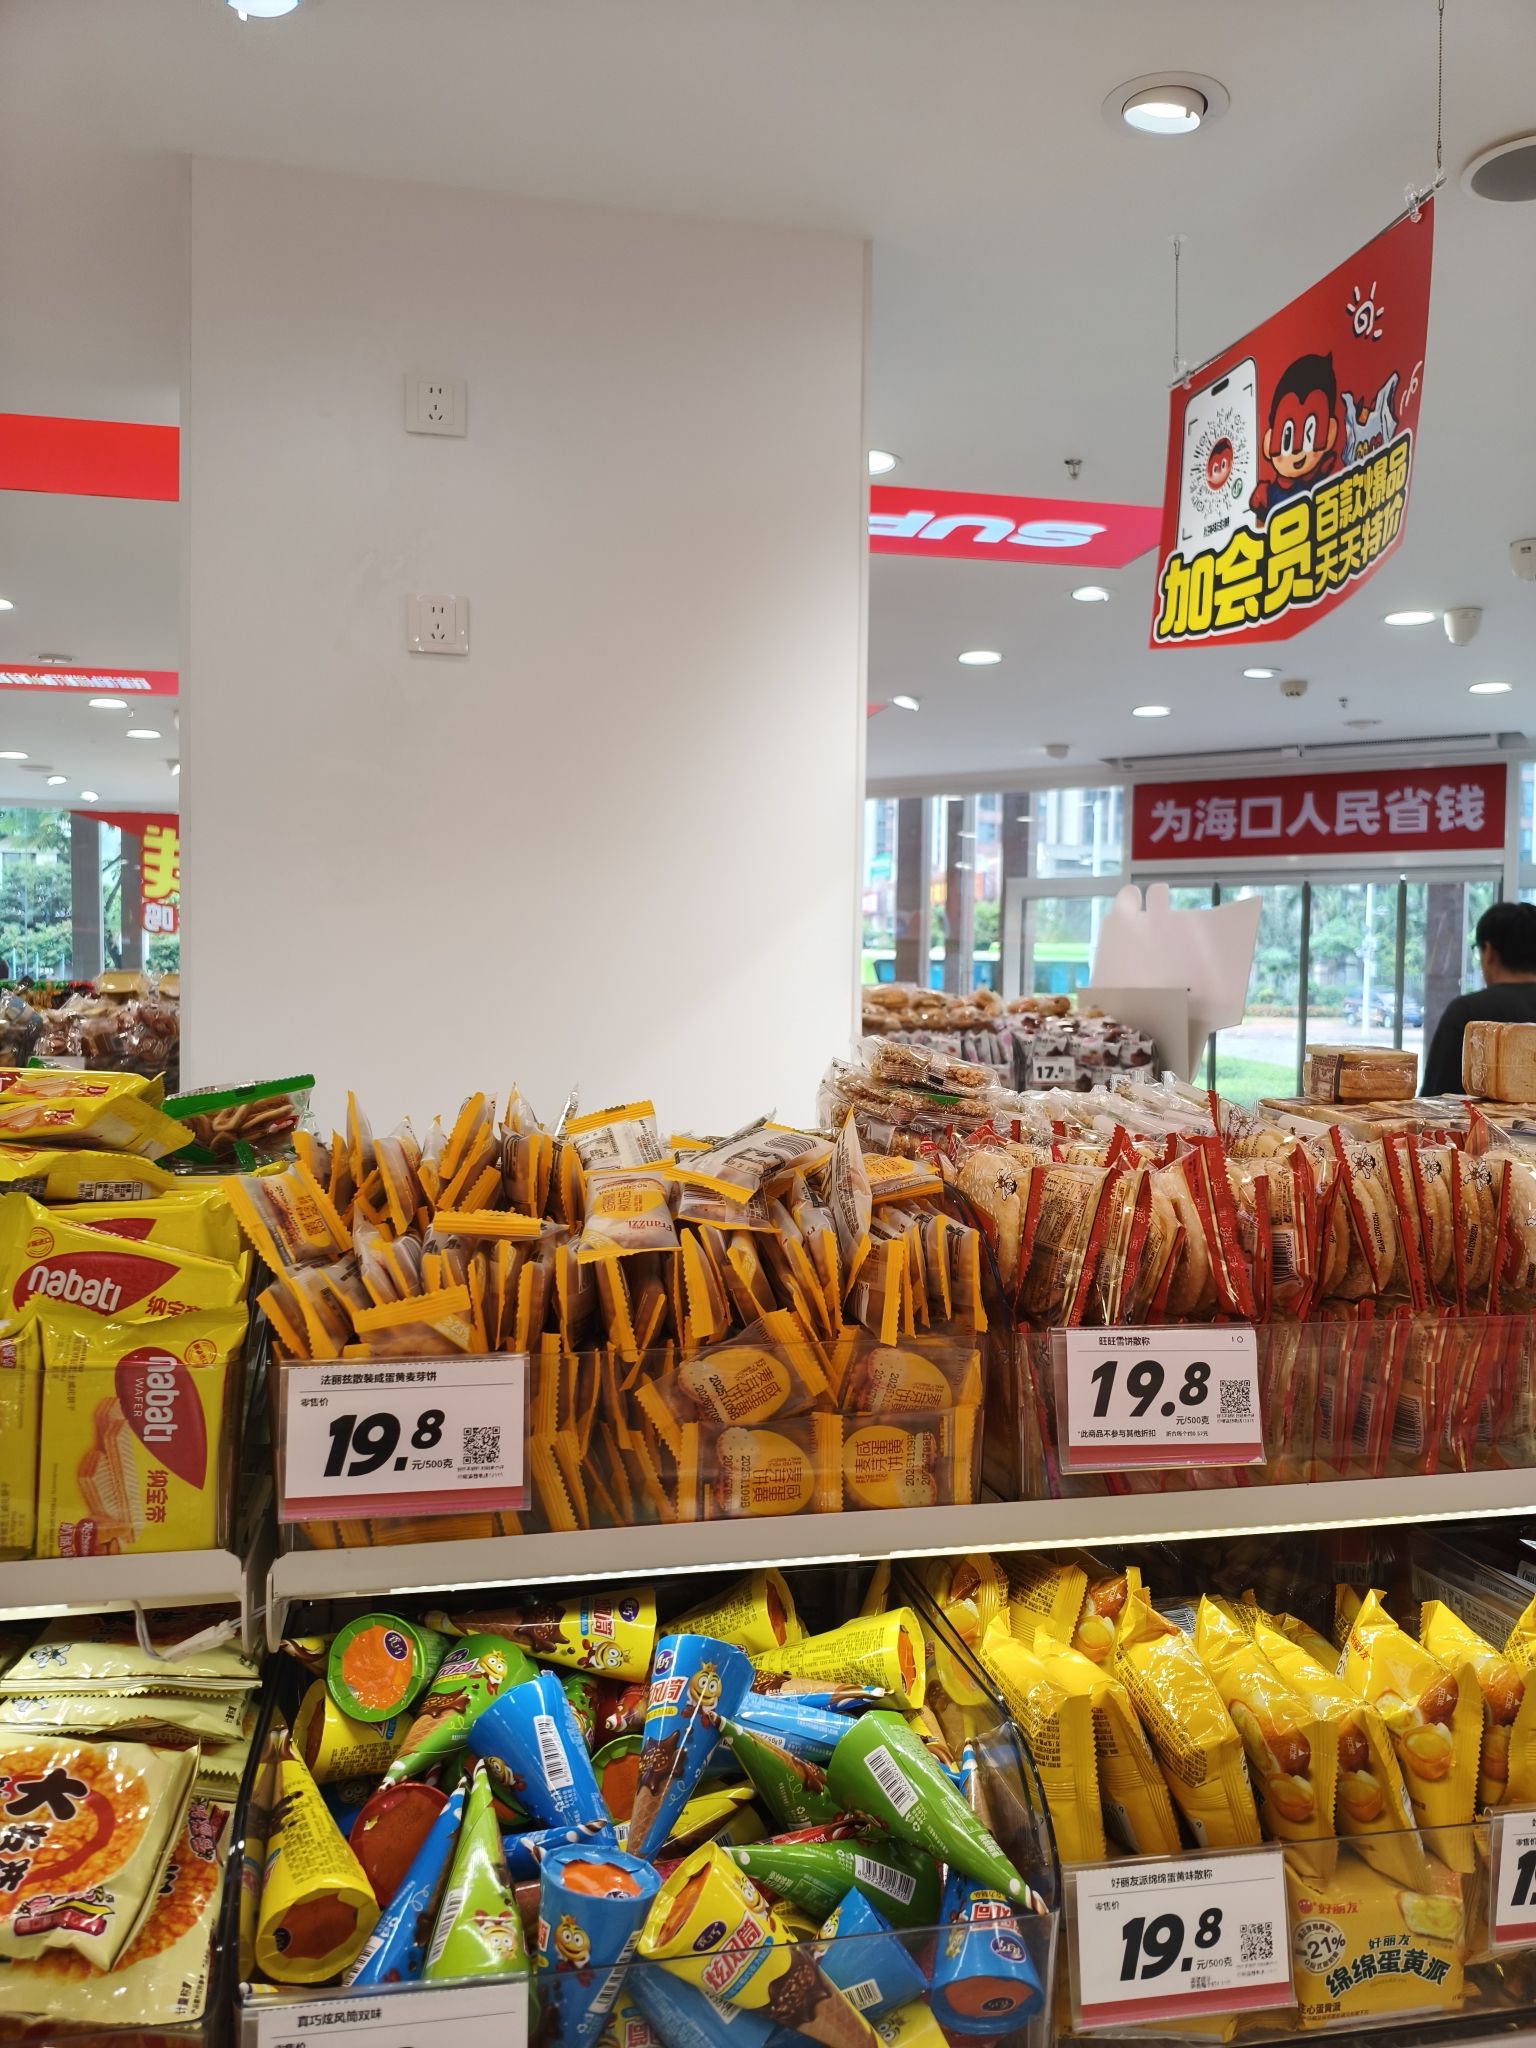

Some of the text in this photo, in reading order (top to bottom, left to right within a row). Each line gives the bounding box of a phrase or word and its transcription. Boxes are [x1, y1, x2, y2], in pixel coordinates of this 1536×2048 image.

[1315, 441, 1408, 536] 百款爆品
[1314, 502, 1403, 594] 天天特价
[1159, 502, 1314, 636] 加会员
[1149, 784, 1486, 844] 为海口人民省钱
[27, 1265, 122, 1312] nabati
[1098, 1337, 1151, 1346] 旺旺雪饼散称
[133, 1377, 145, 1417] WAFER
[320, 1370, 437, 1386] 法丽兹散装咸蛋黄麦芽饼
[1090, 1359, 1212, 1418] 19.8
[143, 1356, 181, 1442] nabati
[300, 1397, 329, 1407] 零售价
[1175, 1415, 1210, 1425] 元/500克
[323, 1408, 446, 1478] 19.8
[411, 1458, 453, 1470] 元/500克
[145, 1469, 169, 1523] 纳宝帝
[5, 1767, 88, 1820] 大
[1111, 1868, 1213, 1889] 好丽友派绵绵蛋黄味散称
[1095, 1901, 1120, 1911] 零售价
[1318, 1902, 1359, 1914] 好丽友
[1119, 1907, 1224, 1982] 19.8
[1307, 1934, 1346, 1960] 21%
[1368, 1934, 1411, 1950] 好丽友
[1196, 1956, 1233, 1971] 元/500克
[1325, 1948, 1451, 1998] 绵绵蛋黄派
[297, 2008, 383, 2027] 真巧炫风筒双味
